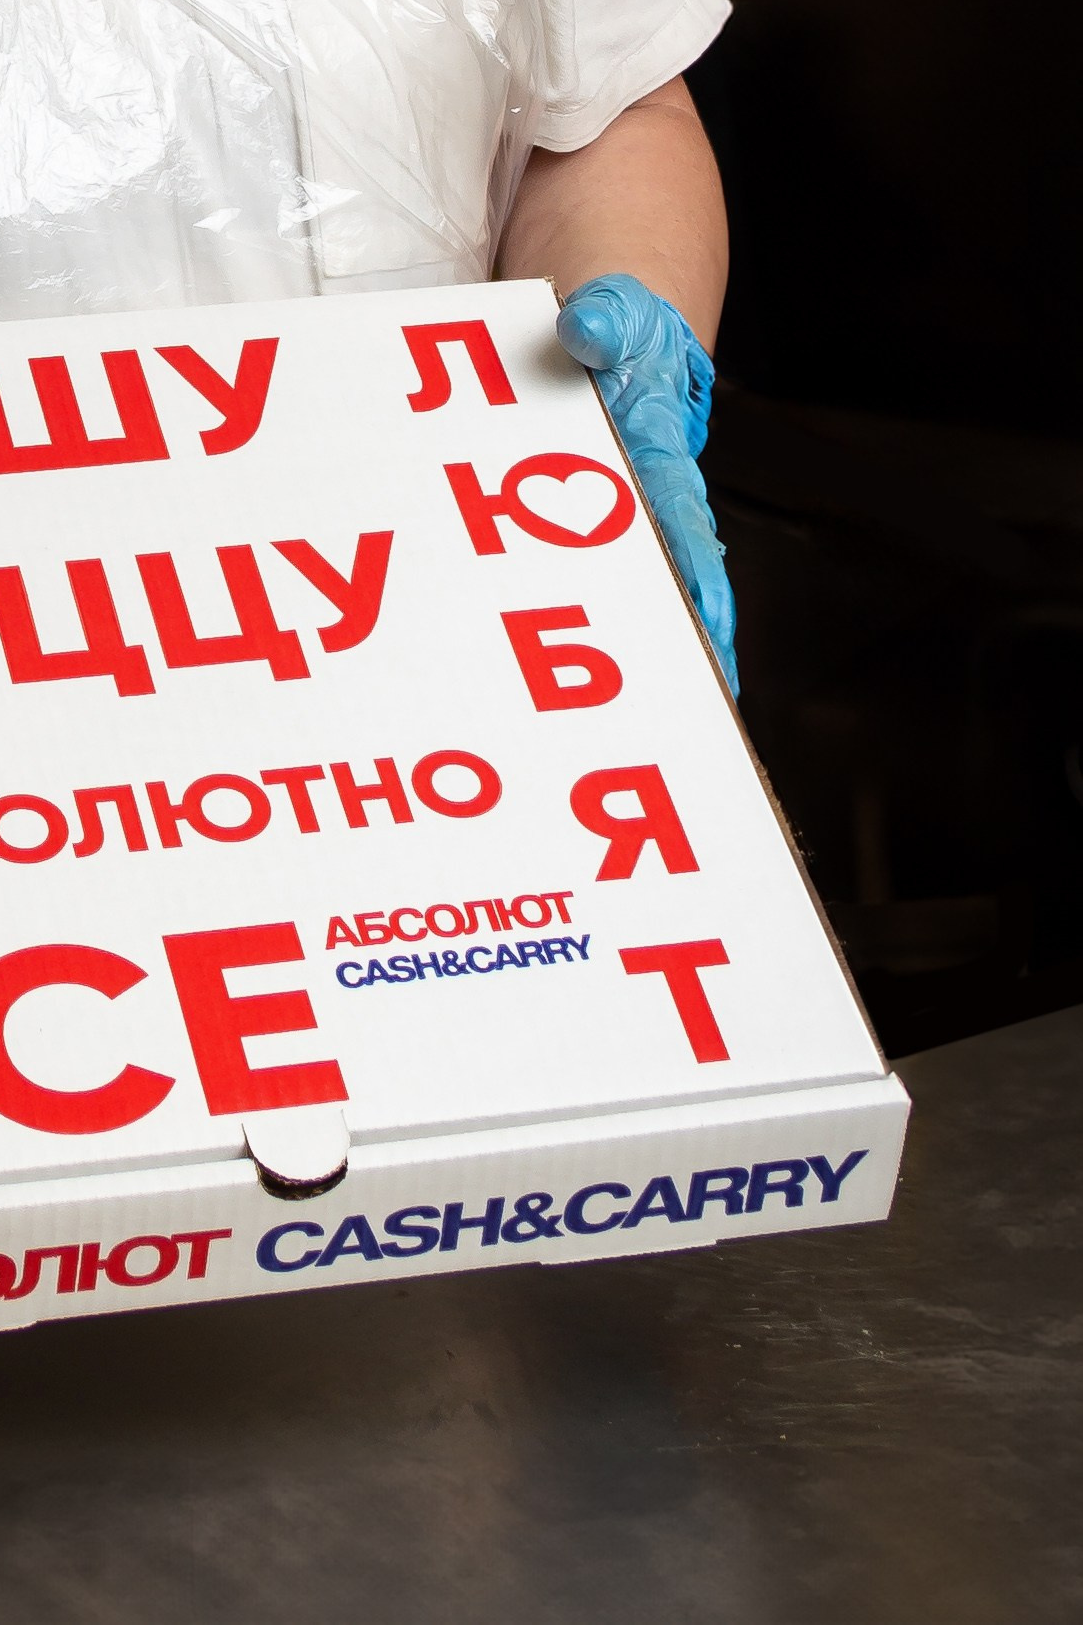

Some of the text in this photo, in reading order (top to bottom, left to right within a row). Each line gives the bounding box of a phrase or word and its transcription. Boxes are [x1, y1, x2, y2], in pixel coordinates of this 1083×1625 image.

[325, 890, 574, 951] АБСОЛЮТ
[335, 934, 591, 989] CASH&CARRY
[256, 1150, 870, 1273] CASH&CARRY
